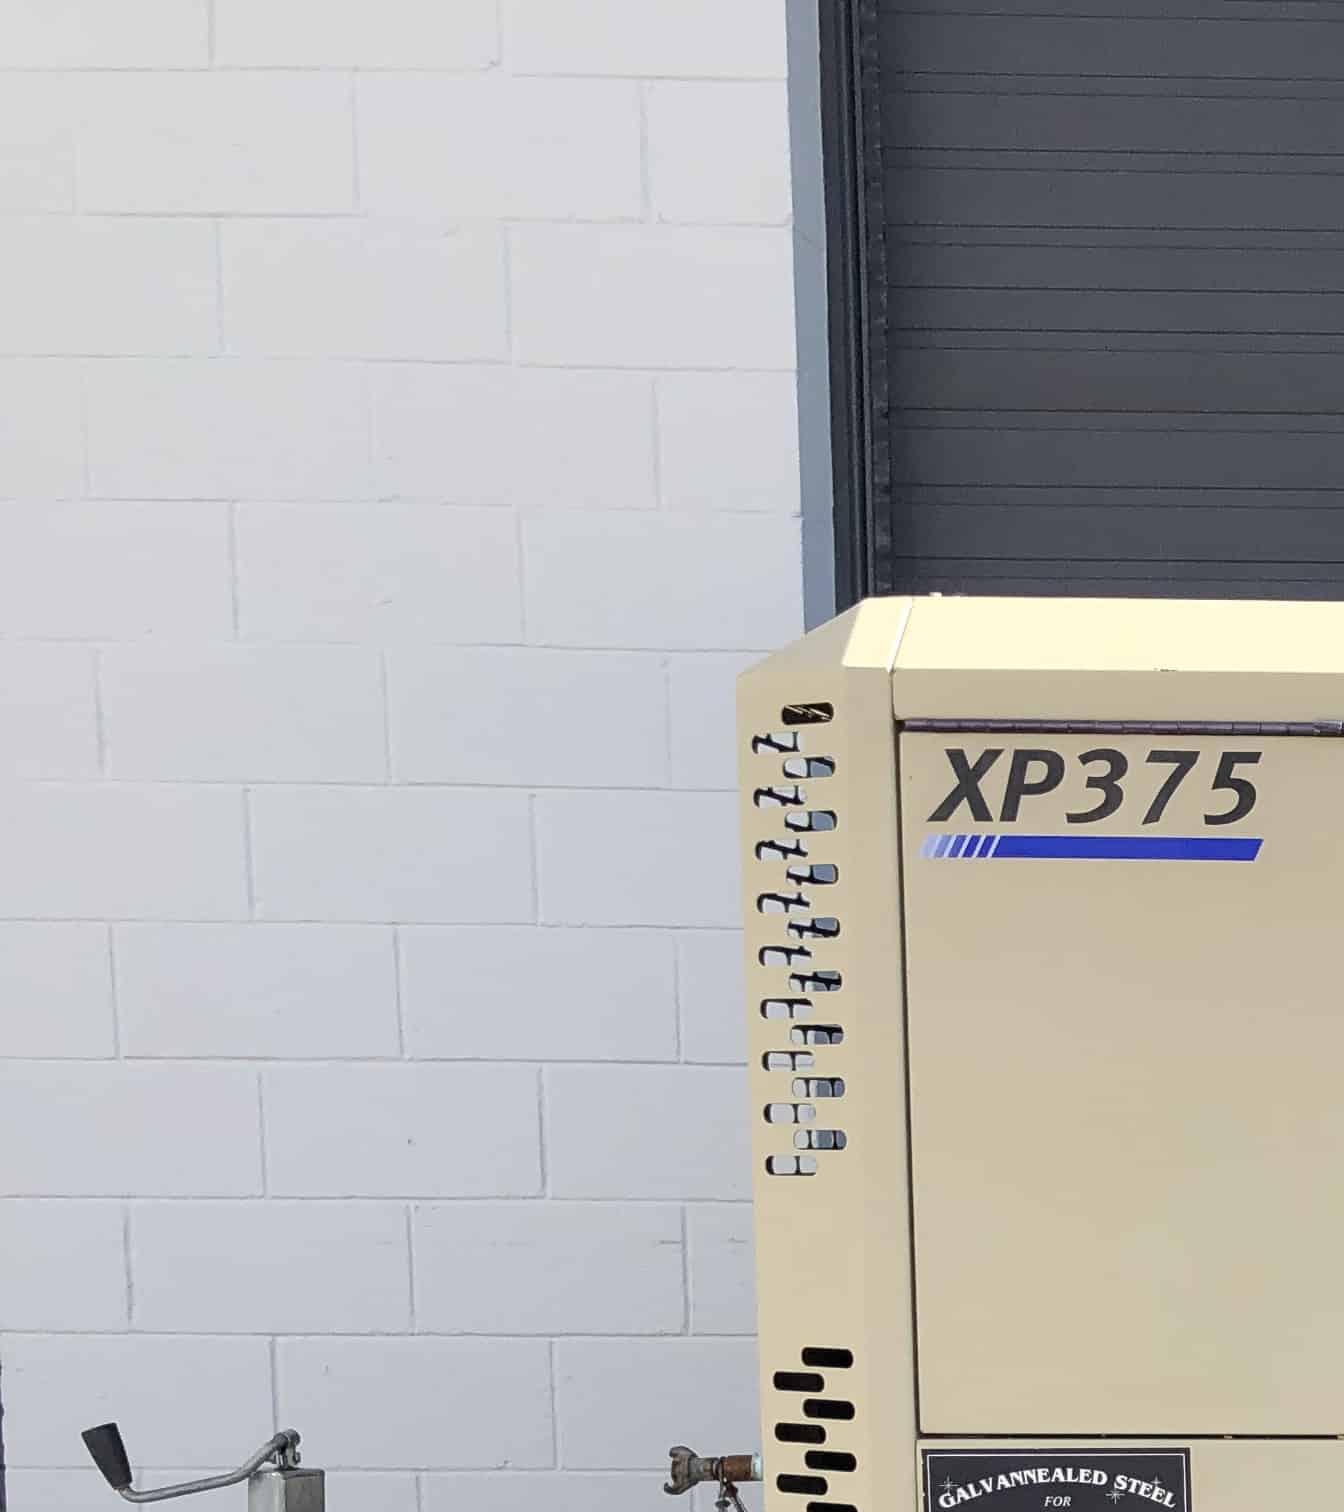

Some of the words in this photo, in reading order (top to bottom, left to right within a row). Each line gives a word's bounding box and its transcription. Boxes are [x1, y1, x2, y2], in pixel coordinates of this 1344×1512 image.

[927, 748, 1263, 826] XP375
[938, 1467, 1108, 1509] GALVANNEALED
[1113, 1474, 1177, 1510] STEEL
[1044, 1496, 1072, 1508] FOR
